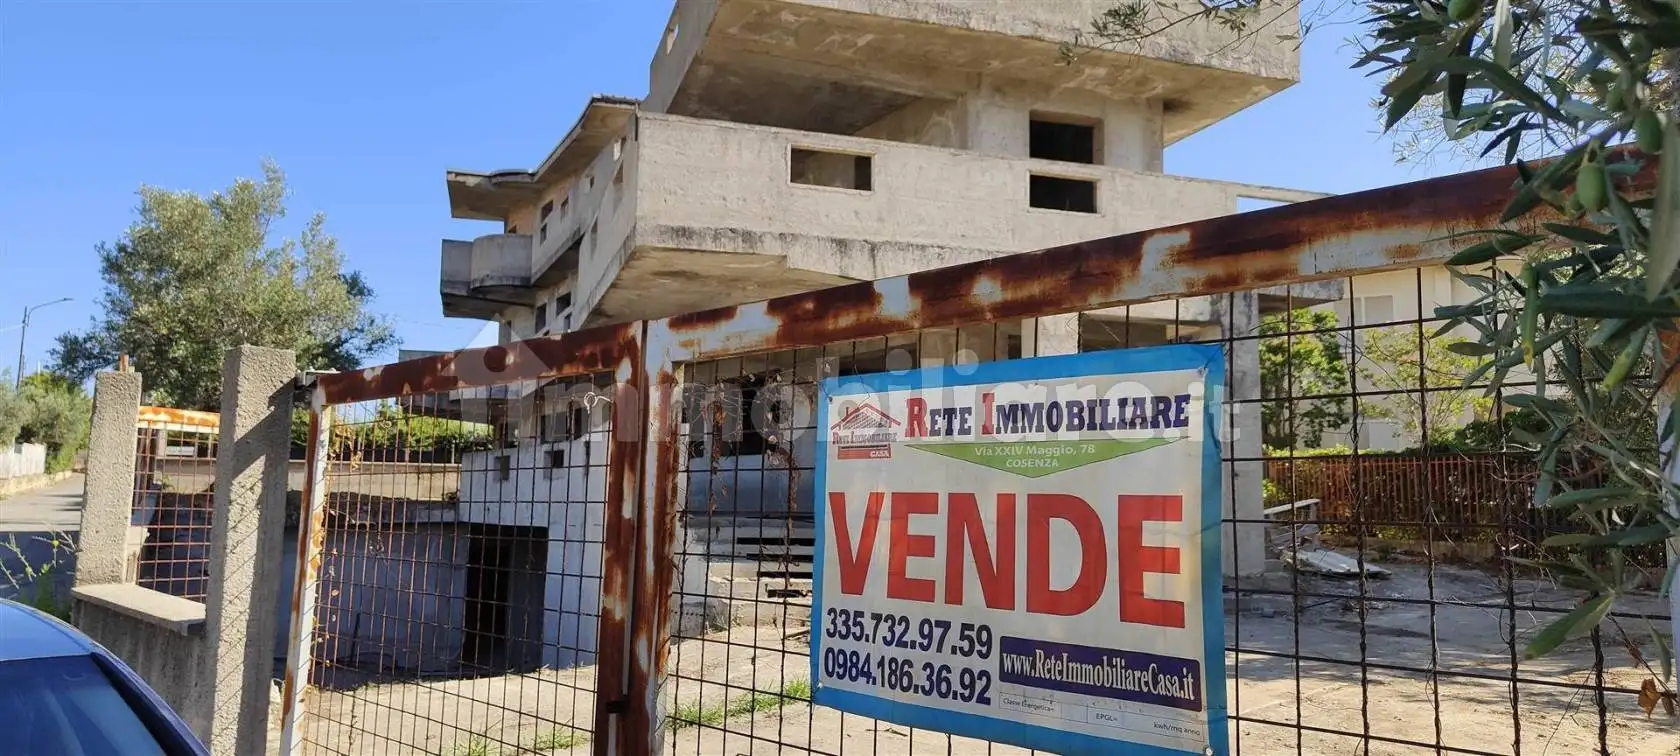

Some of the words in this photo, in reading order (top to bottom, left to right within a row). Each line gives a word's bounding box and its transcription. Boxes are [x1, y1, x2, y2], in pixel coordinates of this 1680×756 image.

[904, 397, 973, 438] RETE
[981, 392, 1192, 436] IMMOBILIARE
[870, 449, 890, 458] CASA
[974, 446, 994, 457] Via
[994, 445, 1023, 456] XXIV
[1026, 443, 1078, 457] Maggio,
[1080, 443, 1096, 455] 78
[1005, 458, 1060, 469] COSENZA
[828, 491, 1186, 629] VENDE
[825, 607, 993, 660] 335.732.97.59
[824, 646, 992, 706] 0984.186.36.92
[1002, 649, 1195, 701] www.ReteImmobiliareCasa.it
